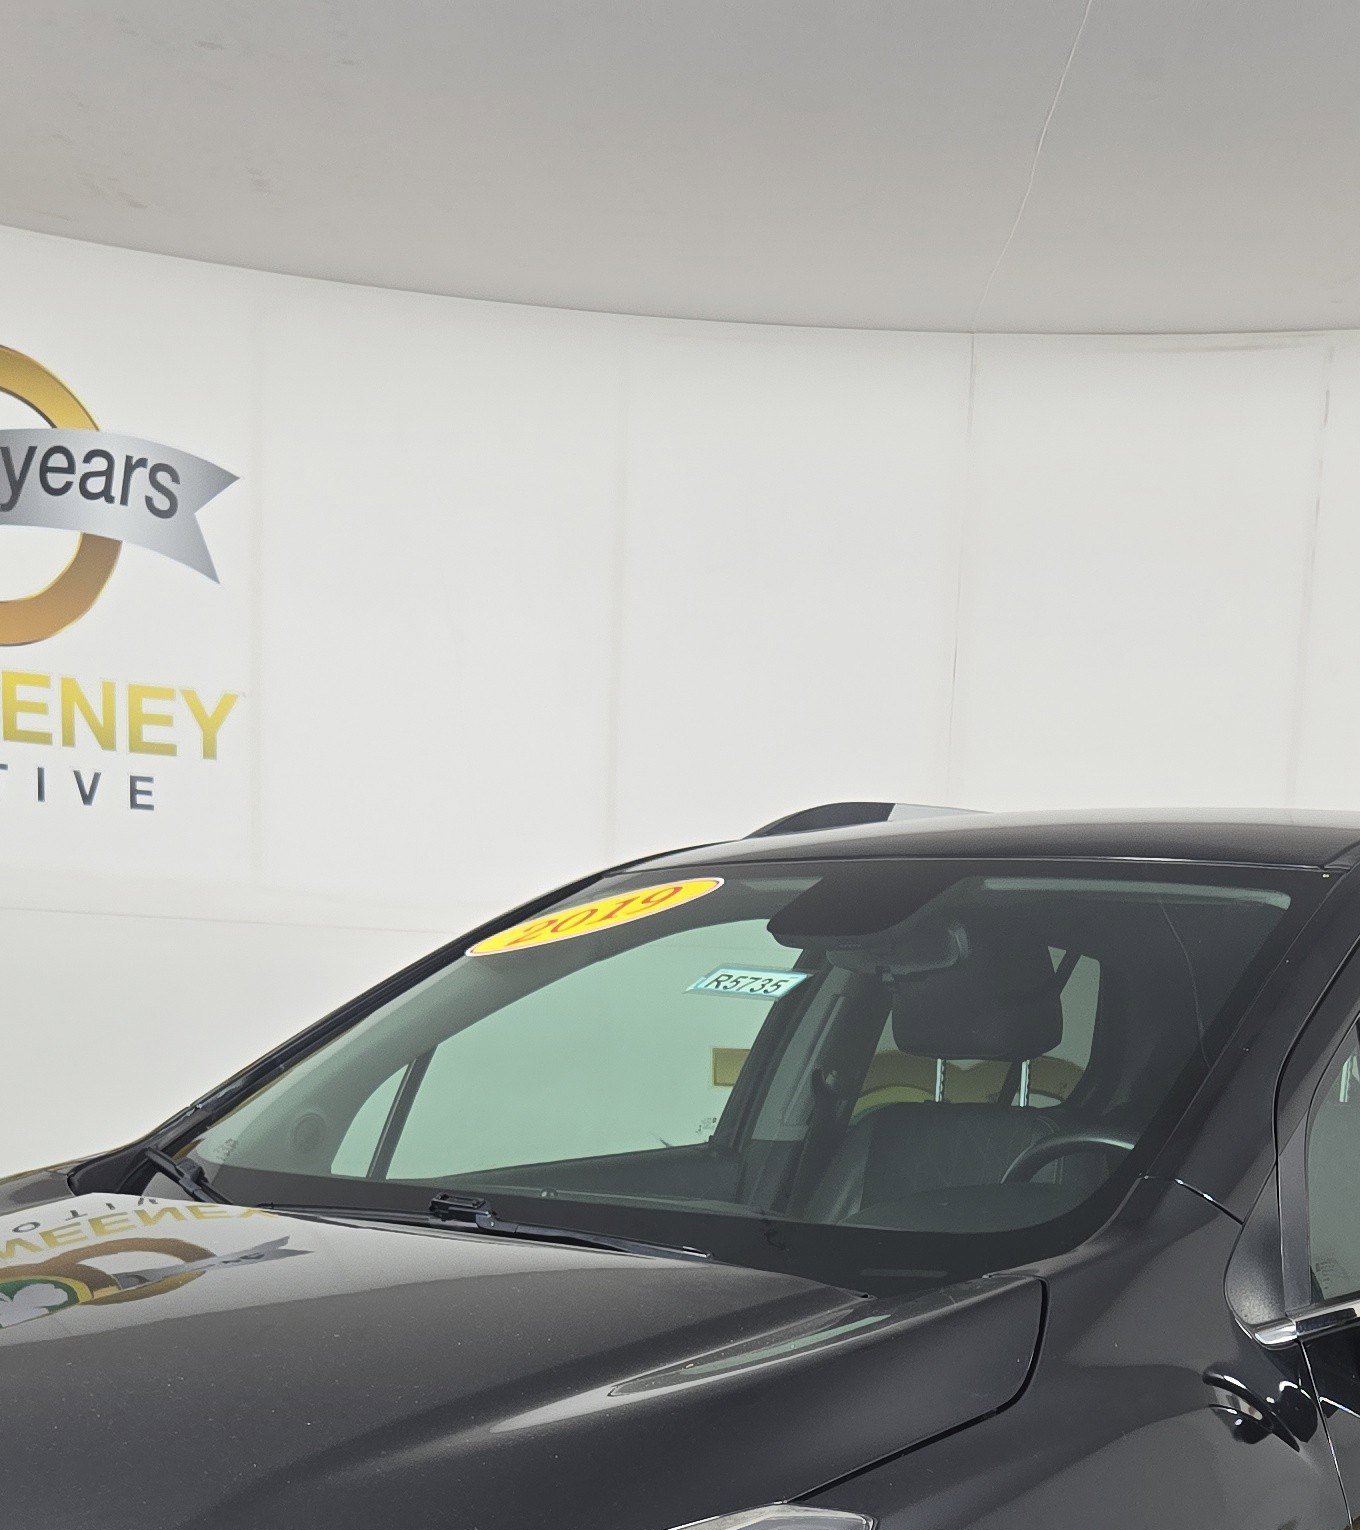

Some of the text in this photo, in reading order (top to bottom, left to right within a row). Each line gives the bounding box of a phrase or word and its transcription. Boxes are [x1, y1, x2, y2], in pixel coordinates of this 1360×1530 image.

[0, 443, 181, 520] years
[506, 885, 683, 946] 2019
[705, 972, 790, 995] R5735
